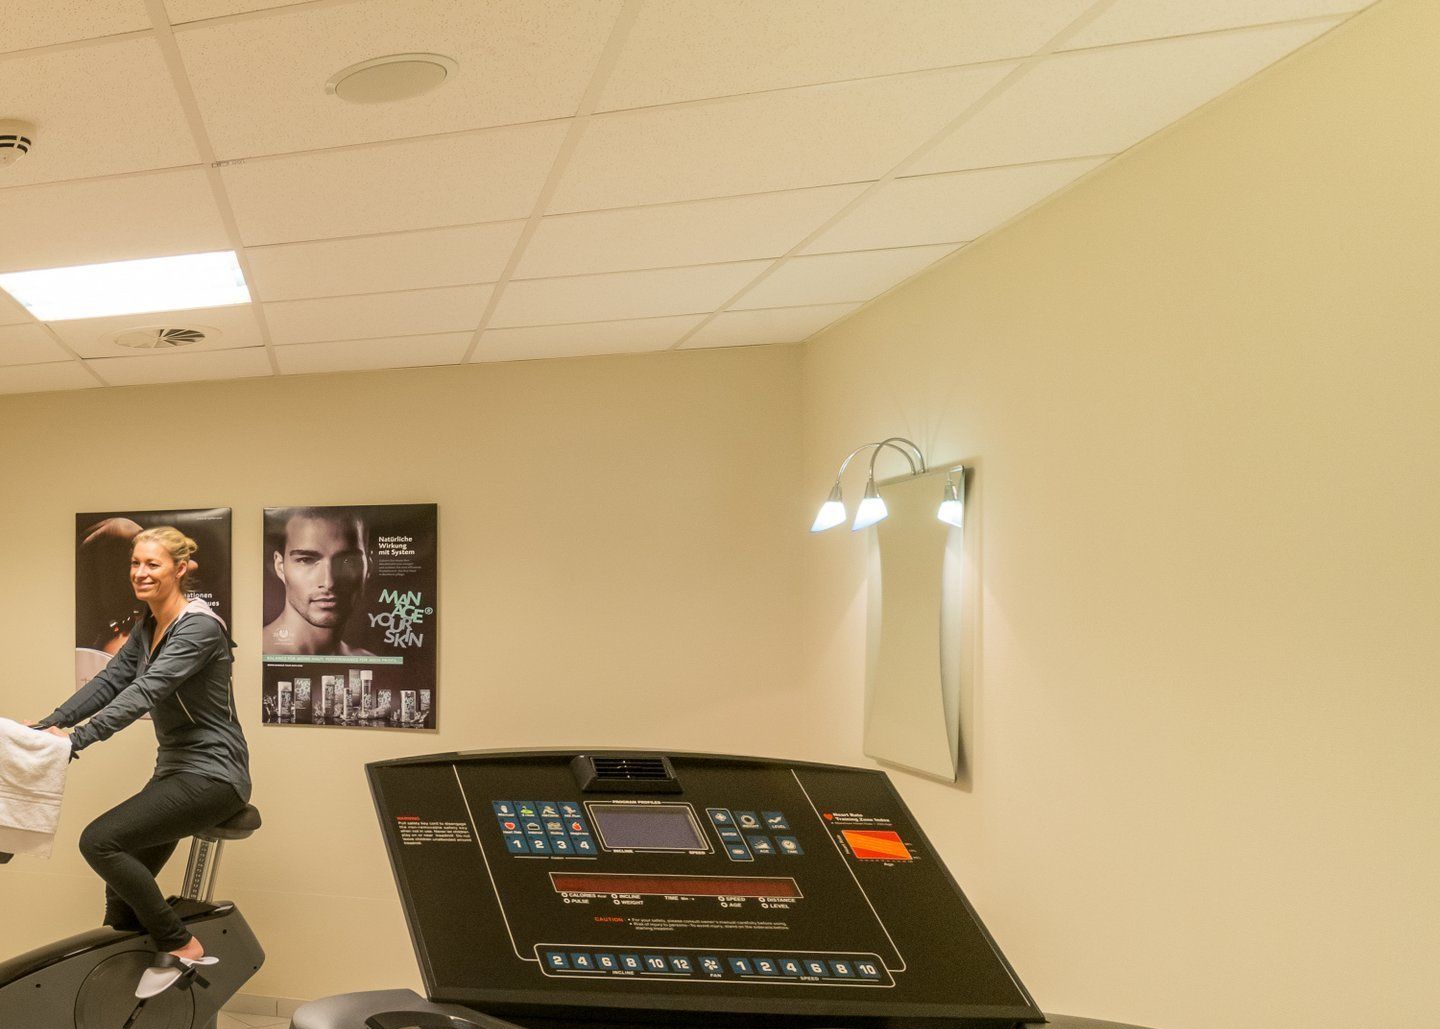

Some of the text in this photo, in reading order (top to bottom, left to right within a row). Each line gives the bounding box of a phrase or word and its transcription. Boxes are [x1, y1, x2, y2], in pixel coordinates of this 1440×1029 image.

[391, 549, 415, 557] System
[378, 588, 422, 606] MAN
[368, 612, 413, 633] YOUR
[383, 628, 424, 648] SKIN
[513, 840, 522, 848] 1
[534, 840, 545, 849] 2
[556, 840, 567, 849] 3
[579, 841, 590, 850] 4
[552, 955, 564, 966] 2
[577, 956, 588, 966] 4
[601, 956, 612, 967] 6
[625, 957, 637, 968] 8
[648, 958, 665, 969] 10
[673, 959, 690, 970] 12
[736, 960, 747, 971] 1
[760, 961, 773, 972] 2
[786, 962, 798, 973] 4
[810, 963, 823, 973] 6
[835, 963, 848, 974] 8
[859, 964, 877, 975] 10
